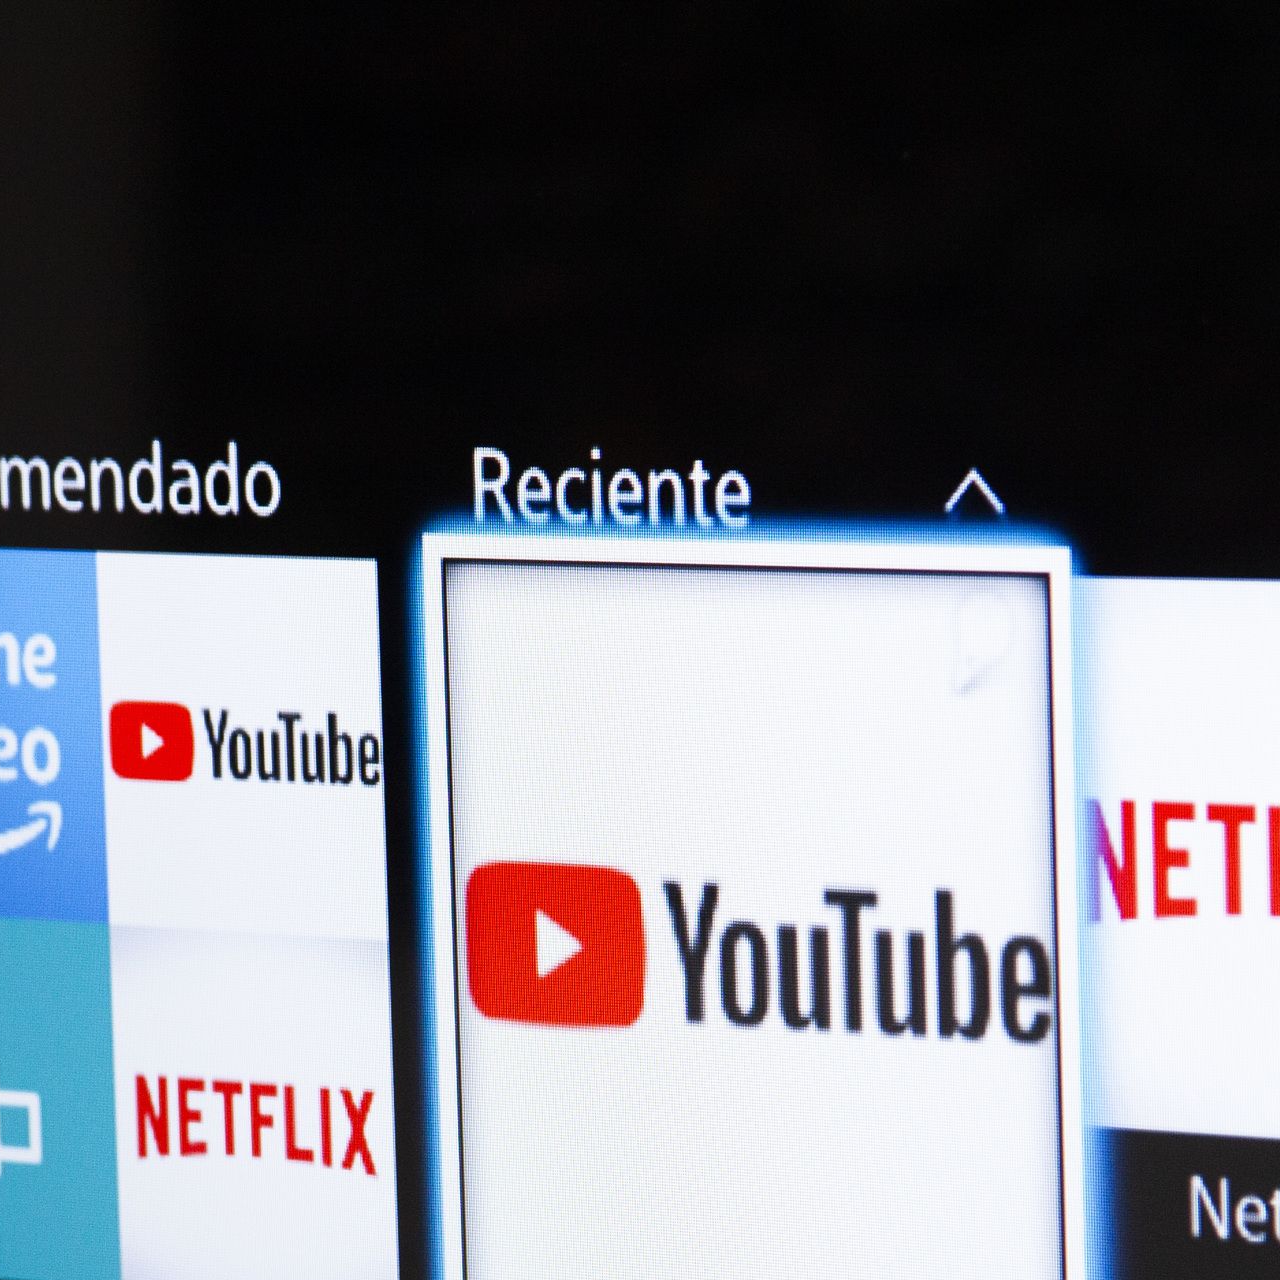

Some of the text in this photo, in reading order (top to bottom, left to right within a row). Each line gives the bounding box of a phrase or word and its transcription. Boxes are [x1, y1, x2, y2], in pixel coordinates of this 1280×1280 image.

[473, 447, 752, 528] Reciente
[203, 708, 381, 787] YouTube
[662, 880, 1052, 1043] YouTube
[135, 1073, 377, 1177] NETFLIX
